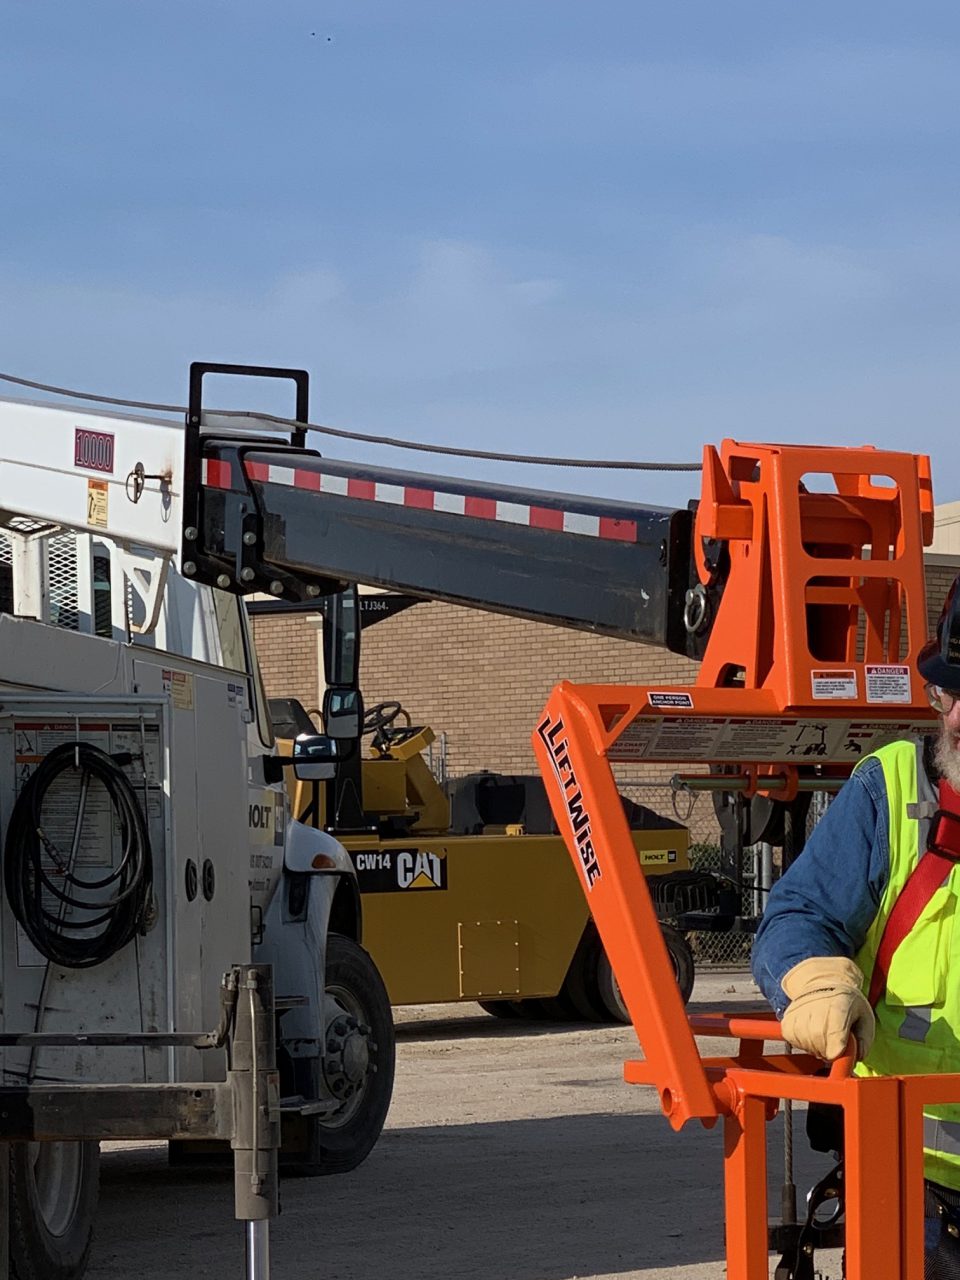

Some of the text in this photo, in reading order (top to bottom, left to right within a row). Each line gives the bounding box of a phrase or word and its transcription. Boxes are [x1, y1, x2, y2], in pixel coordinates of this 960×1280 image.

[76, 432, 113, 470] 10000
[356, 852, 441, 888] CW14 CAT
